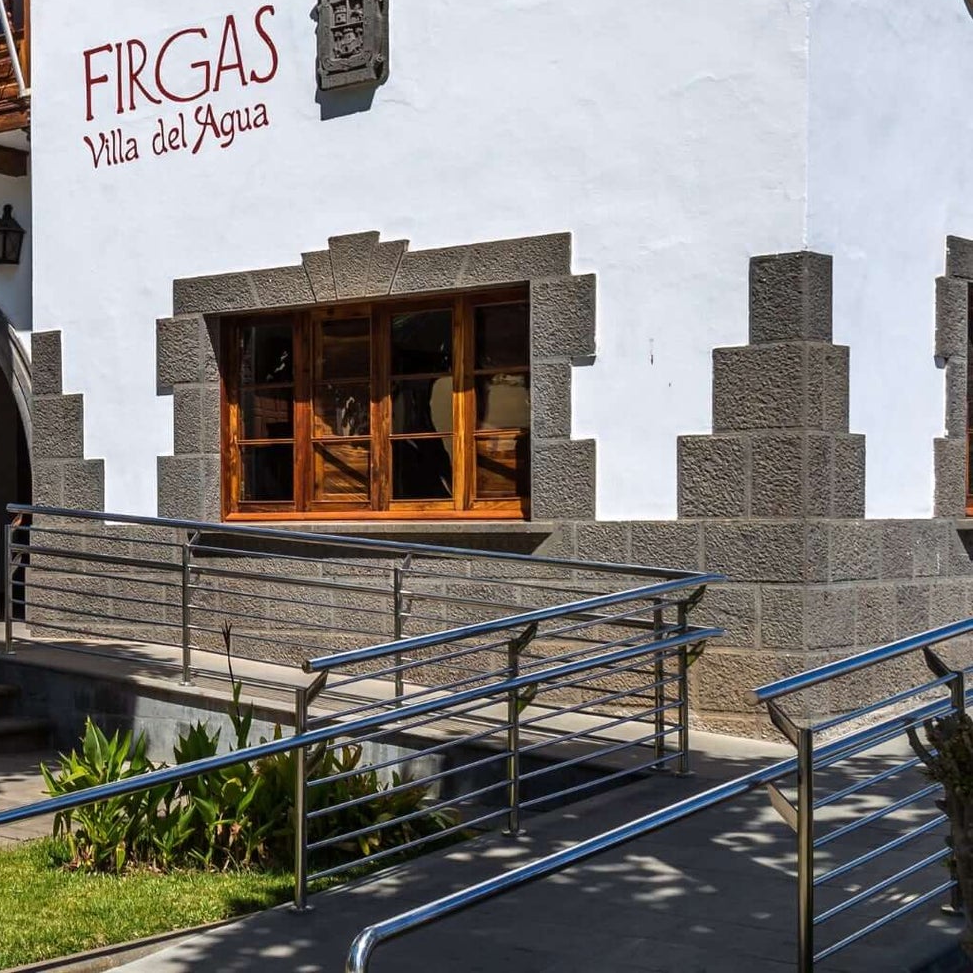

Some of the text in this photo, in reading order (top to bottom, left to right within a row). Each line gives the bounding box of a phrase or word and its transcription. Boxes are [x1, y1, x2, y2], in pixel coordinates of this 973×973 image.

[83, 4, 279, 121] FIRGAS
[83, 102, 270, 169] Villa del Agua
